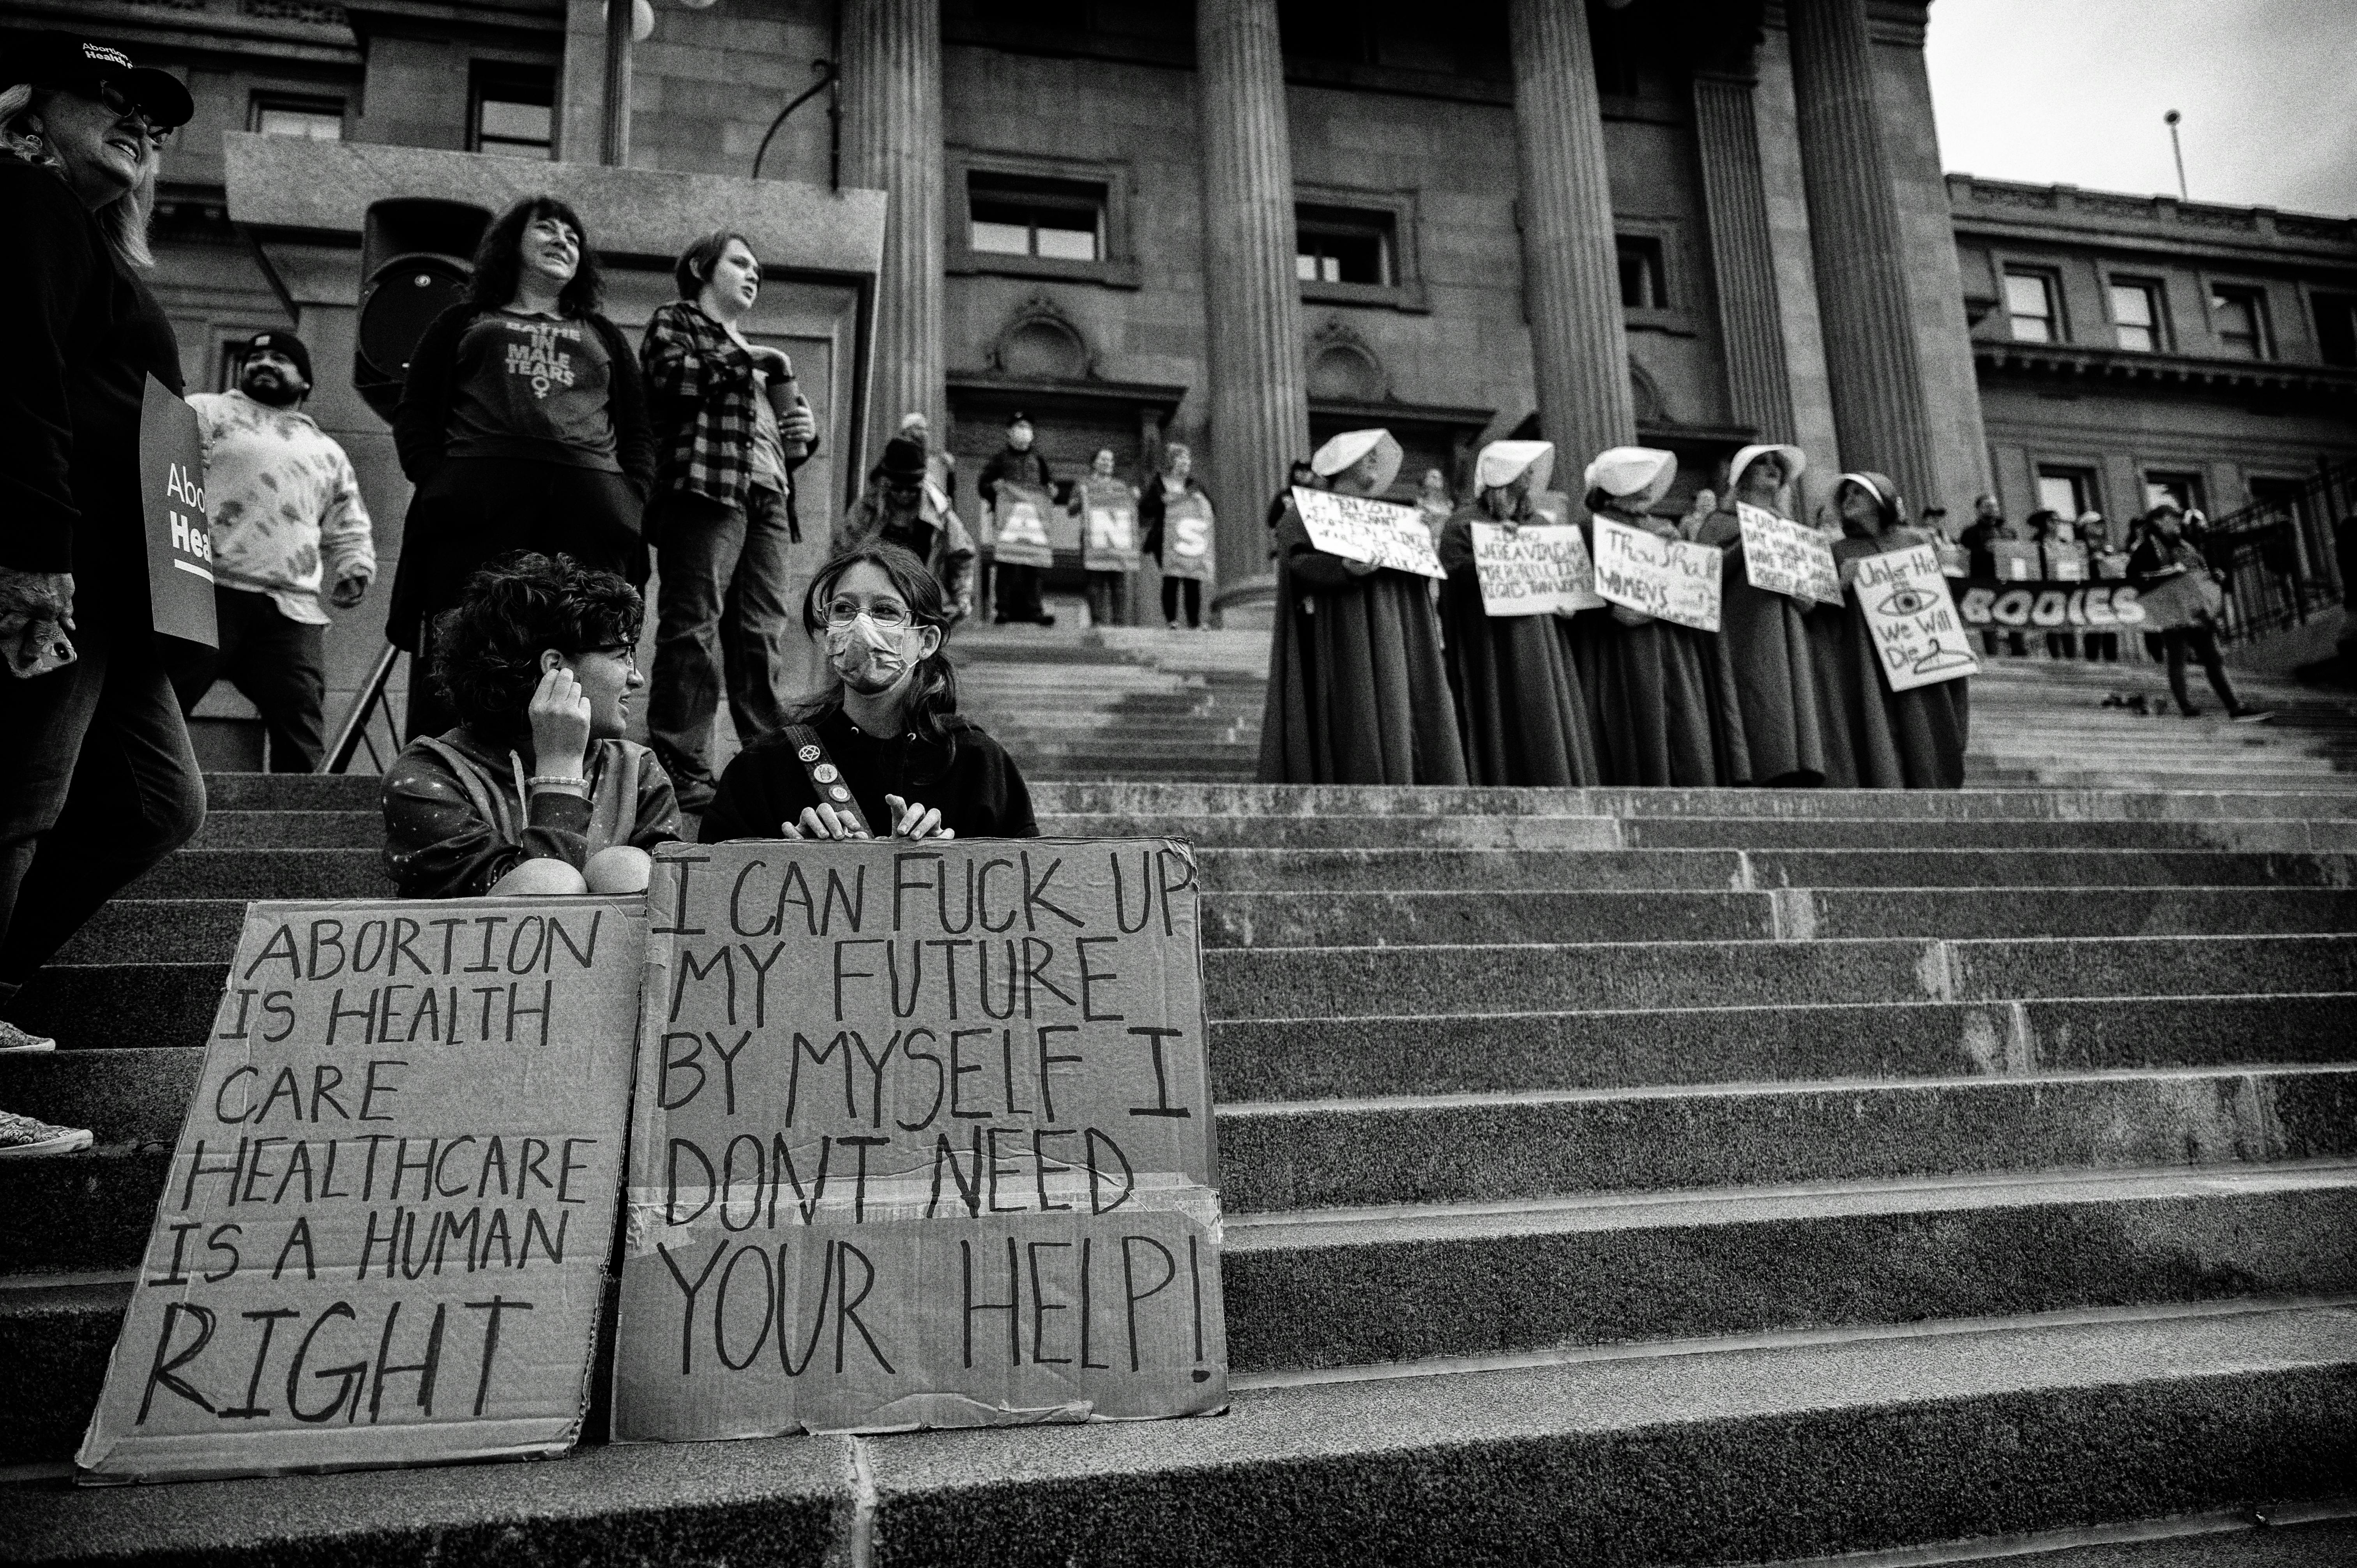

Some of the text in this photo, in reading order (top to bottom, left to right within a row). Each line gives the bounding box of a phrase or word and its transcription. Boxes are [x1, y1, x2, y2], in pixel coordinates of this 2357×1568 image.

[83, 43, 128, 61] Abortion
[85, 51, 126, 67] Health
[505, 358, 575, 387] TEARS
[507, 343, 570, 371] MALE
[531, 334, 555, 353] IN
[167, 463, 205, 513] Abo
[170, 510, 213, 565] Hea
[1089, 509, 1132, 549] N
[1175, 518, 1207, 556] S
[1876, 622, 1914, 643] We
[1961, 586, 2146, 626] BODIES
[652, 848, 1194, 937] I CAN FUCK UP
[244, 911, 601, 980] ABORTION
[218, 980, 552, 1046] IS HEALTH
[669, 937, 1124, 1028] MY FUTURE
[215, 1060, 409, 1124] CARE
[657, 1025, 1191, 1132] BY MYSELF I
[181, 1134, 597, 1211] HEALTHCARE
[666, 1125, 1134, 1232] DONT NEED
[148, 1206, 569, 1287] IS A HUMAN
[657, 1234, 1210, 1383] YOUR HELP!
[135, 1294, 533, 1425] RIGHT
